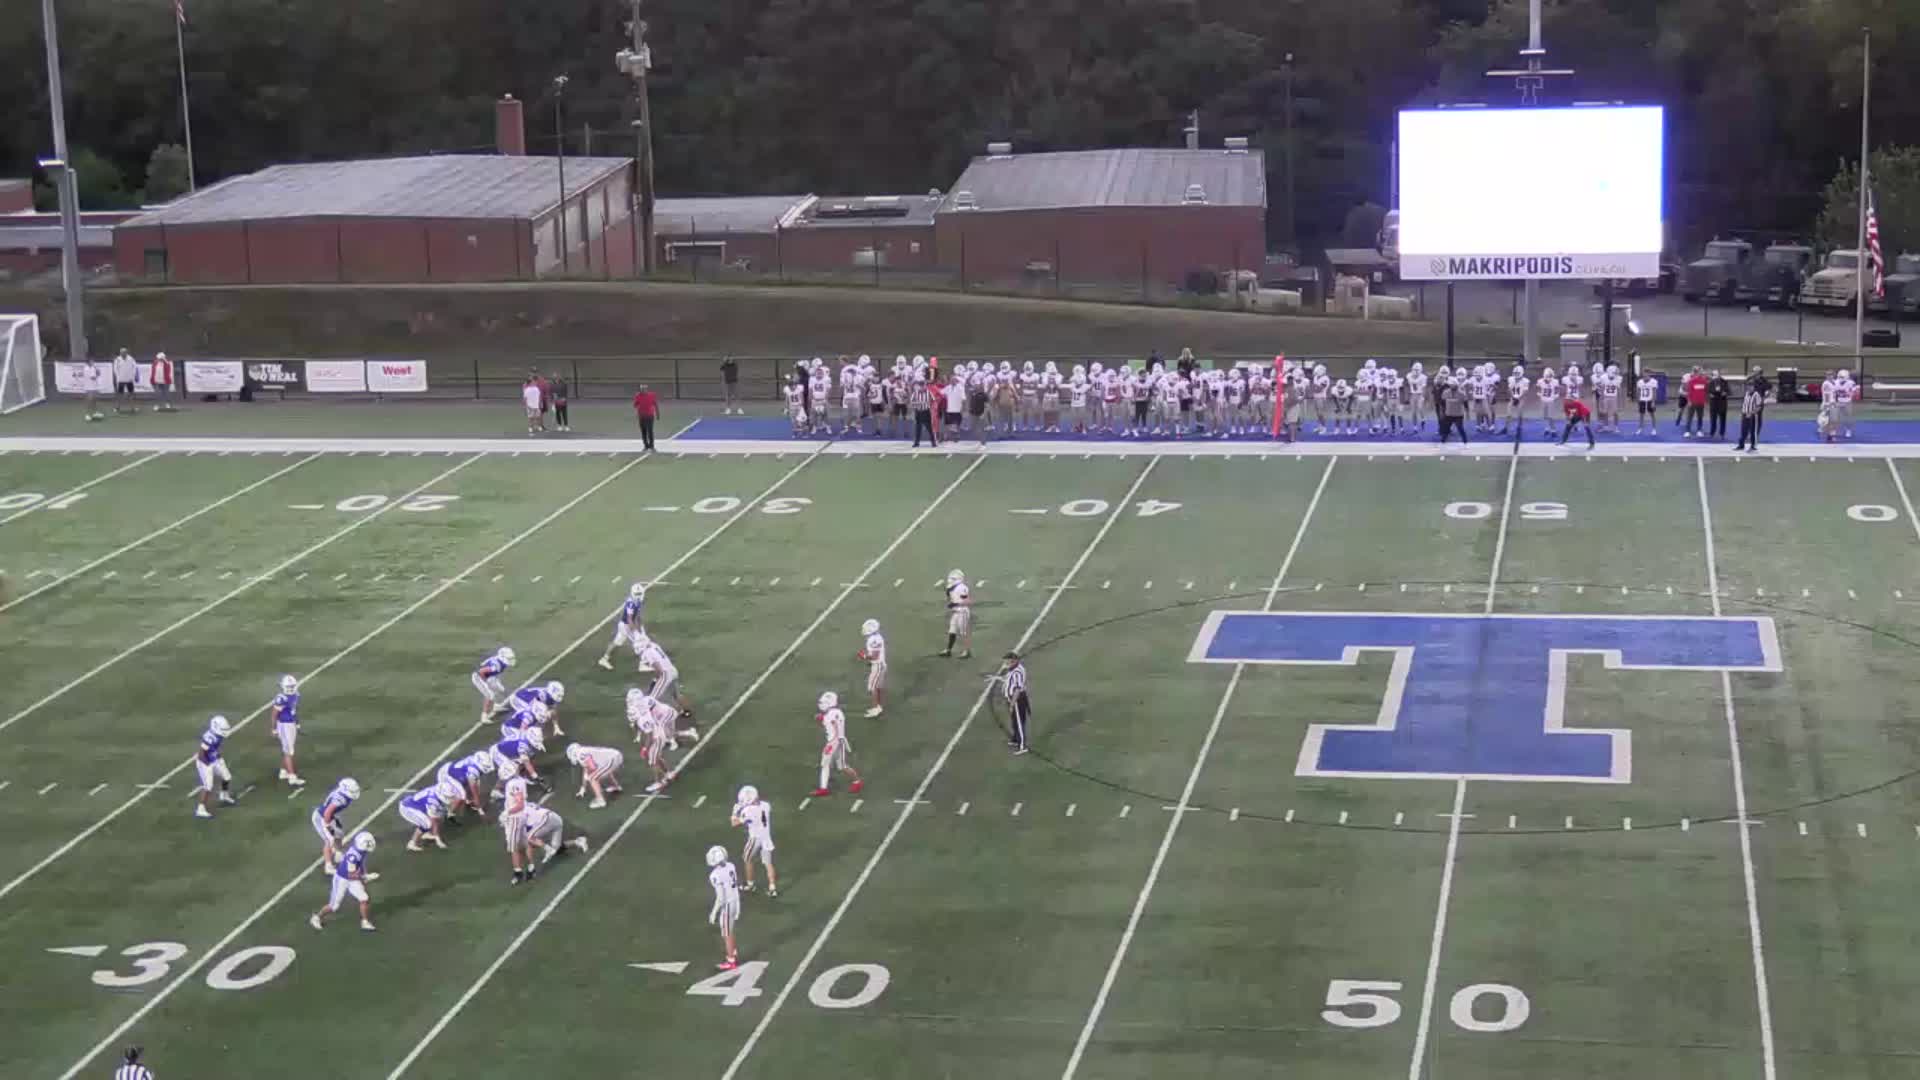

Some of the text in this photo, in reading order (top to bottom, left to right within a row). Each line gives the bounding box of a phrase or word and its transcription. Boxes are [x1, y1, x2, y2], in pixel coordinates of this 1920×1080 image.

[1449, 256, 1573, 275] MAKRIPODIS
[382, 365, 412, 376] West
[1187, 611, 1783, 783] T
